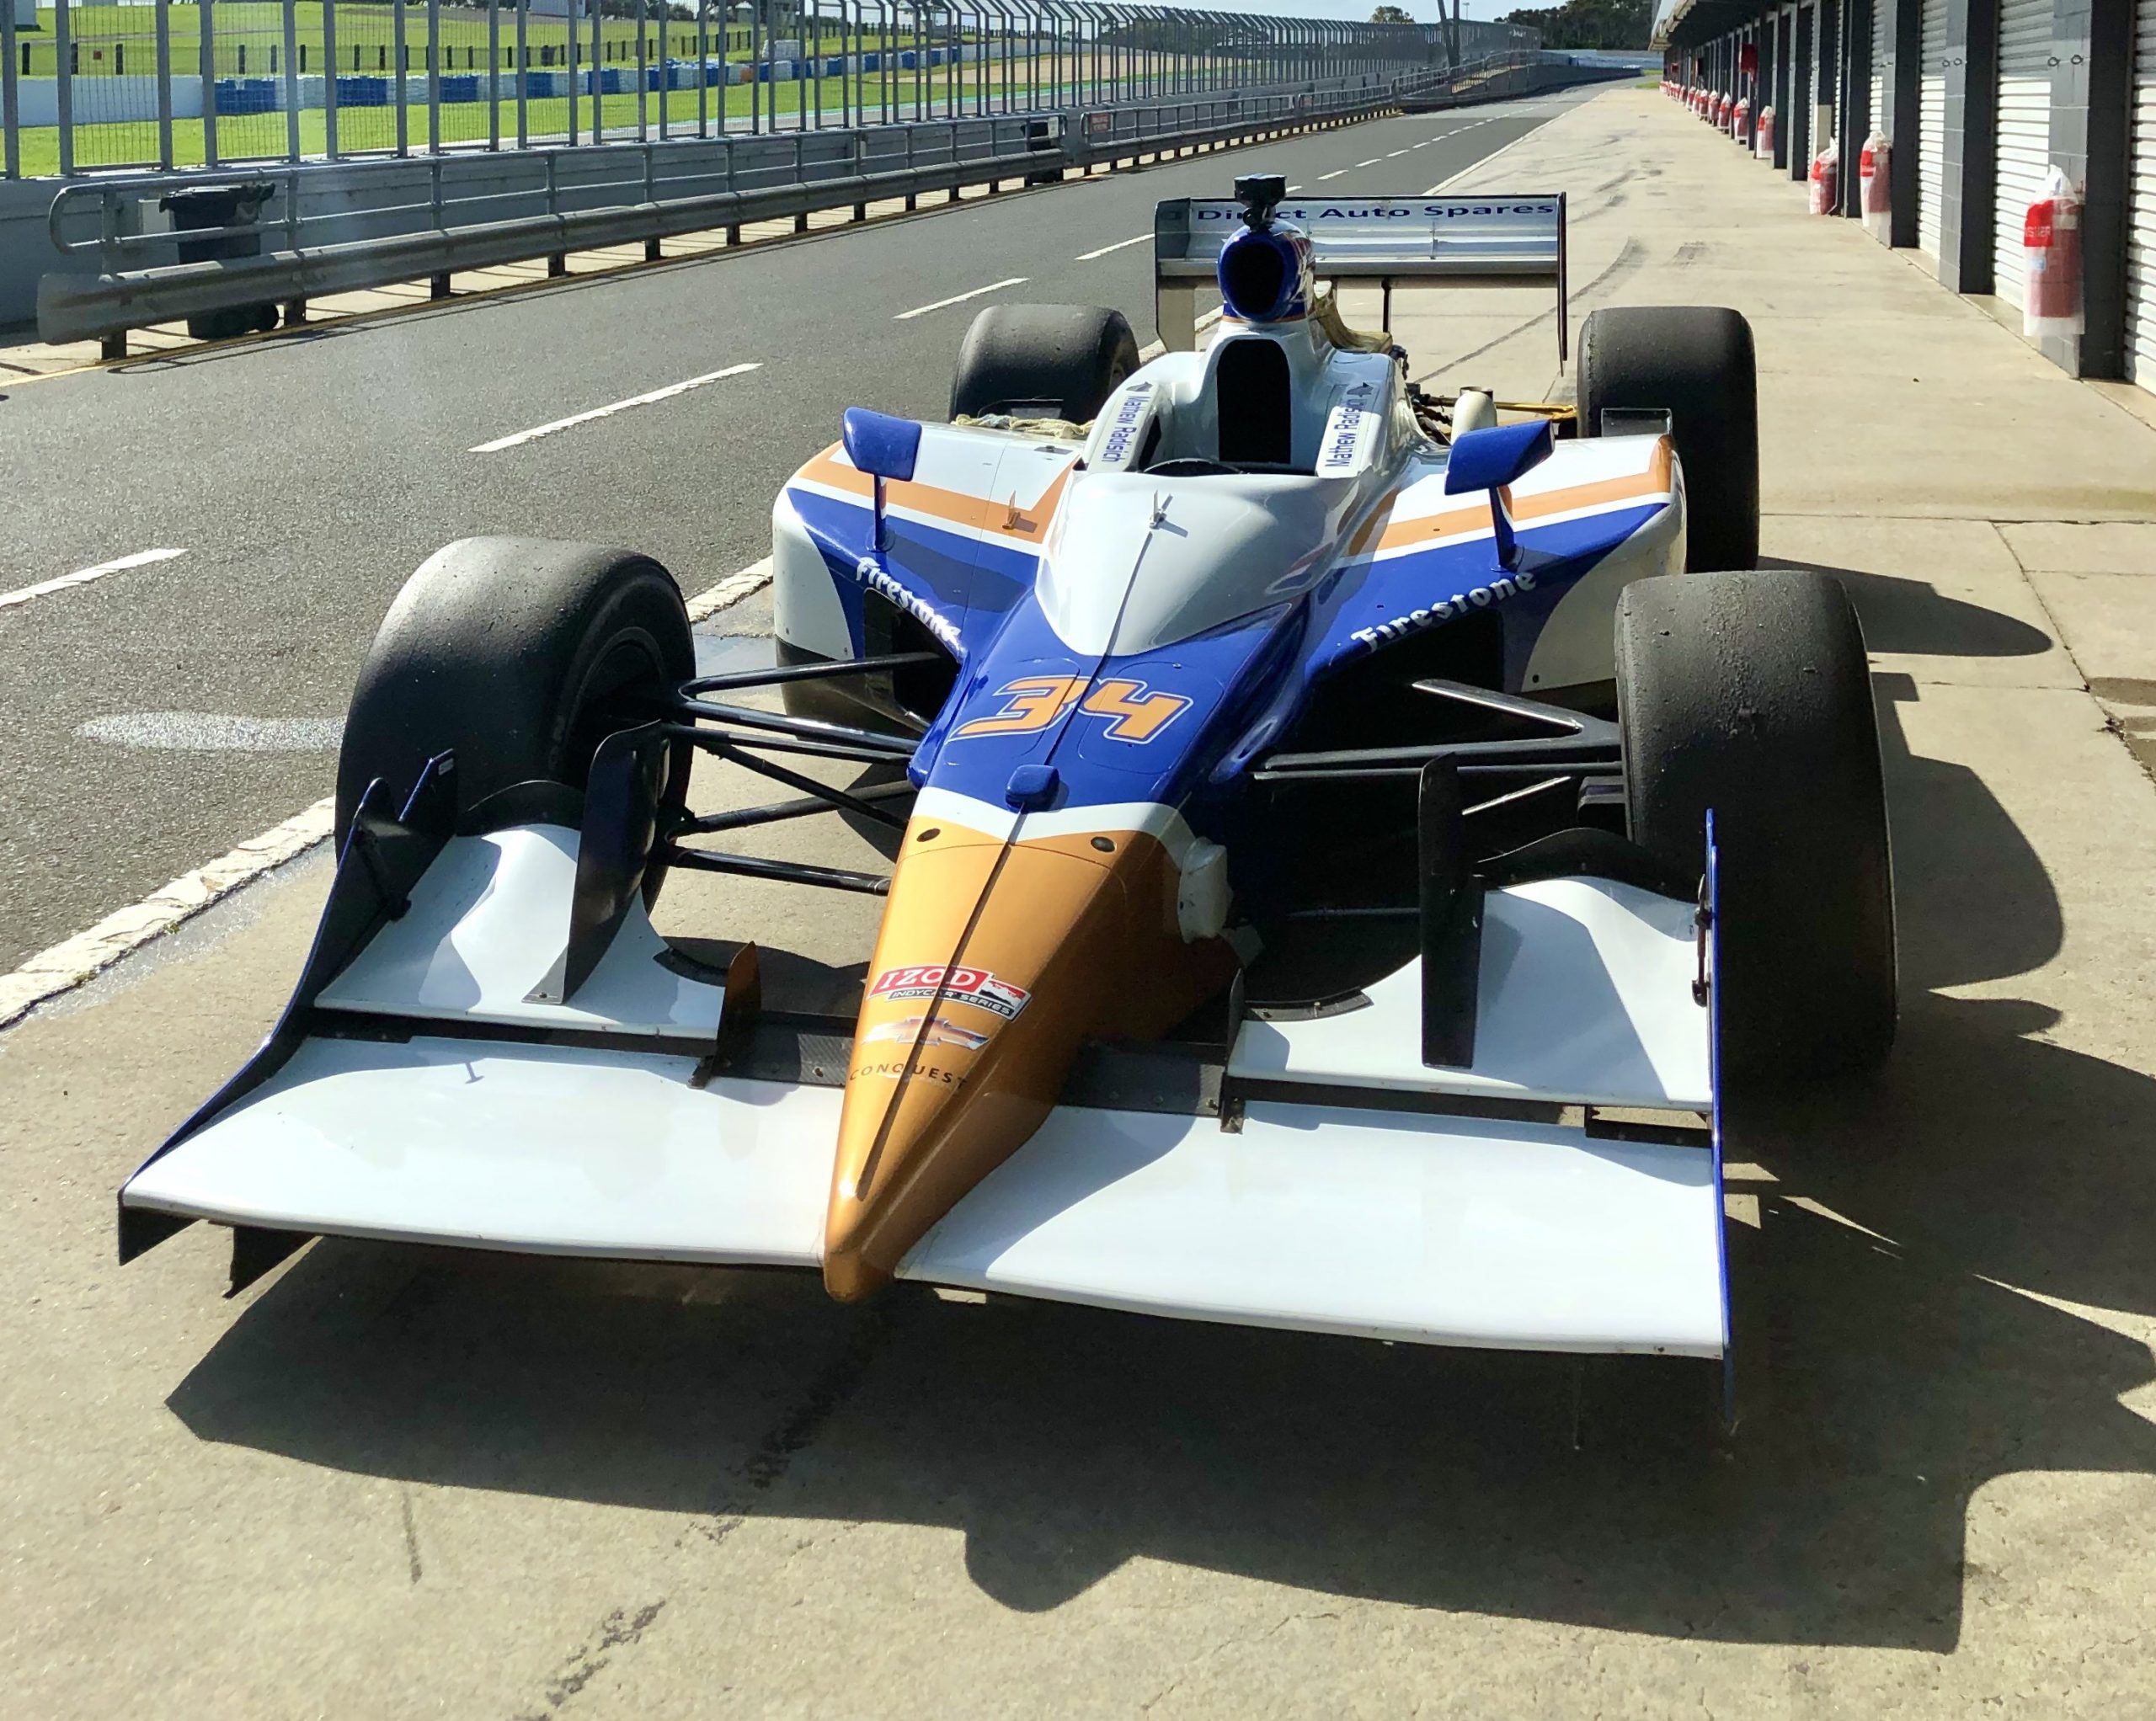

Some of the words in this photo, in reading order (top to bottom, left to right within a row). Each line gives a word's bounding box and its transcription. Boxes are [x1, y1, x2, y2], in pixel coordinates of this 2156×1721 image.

[1318, 206, 1412, 219] Auto
[1423, 205, 1554, 218] Spares
[1325, 432, 1358, 467] Mathew
[1350, 572, 1537, 653] Firestone
[942, 674, 1194, 745] 34
[879, 968, 977, 990] IZOD
[958, 993, 1011, 1015] SERIES
